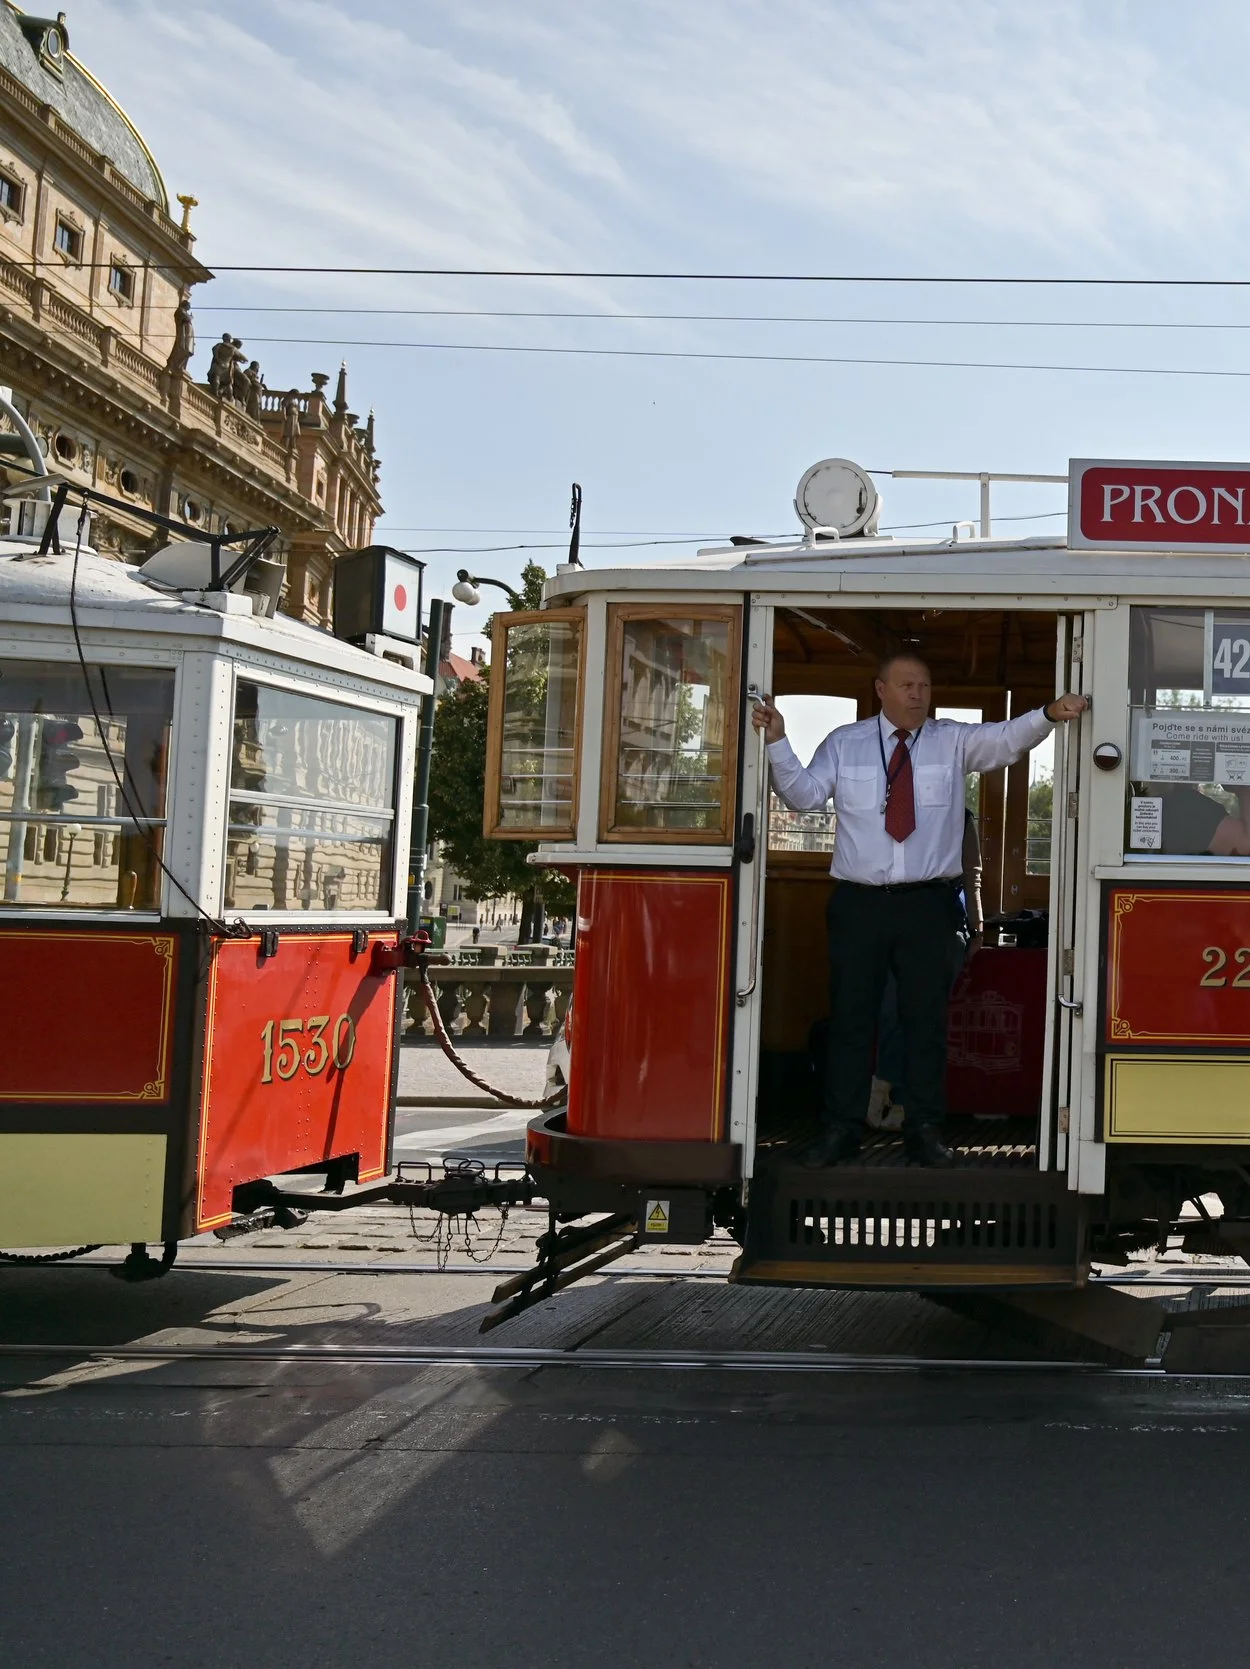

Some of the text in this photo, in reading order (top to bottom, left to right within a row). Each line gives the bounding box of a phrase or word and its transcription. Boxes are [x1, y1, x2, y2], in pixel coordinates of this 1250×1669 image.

[1213, 638, 1250, 678] 42
[1152, 722, 1182, 732] Pojďte
[1206, 724, 1229, 733] námi
[1166, 731, 1191, 740] Come
[1193, 733, 1209, 741] ride
[1211, 734, 1229, 742] with
[260, 1013, 356, 1083] 1530
